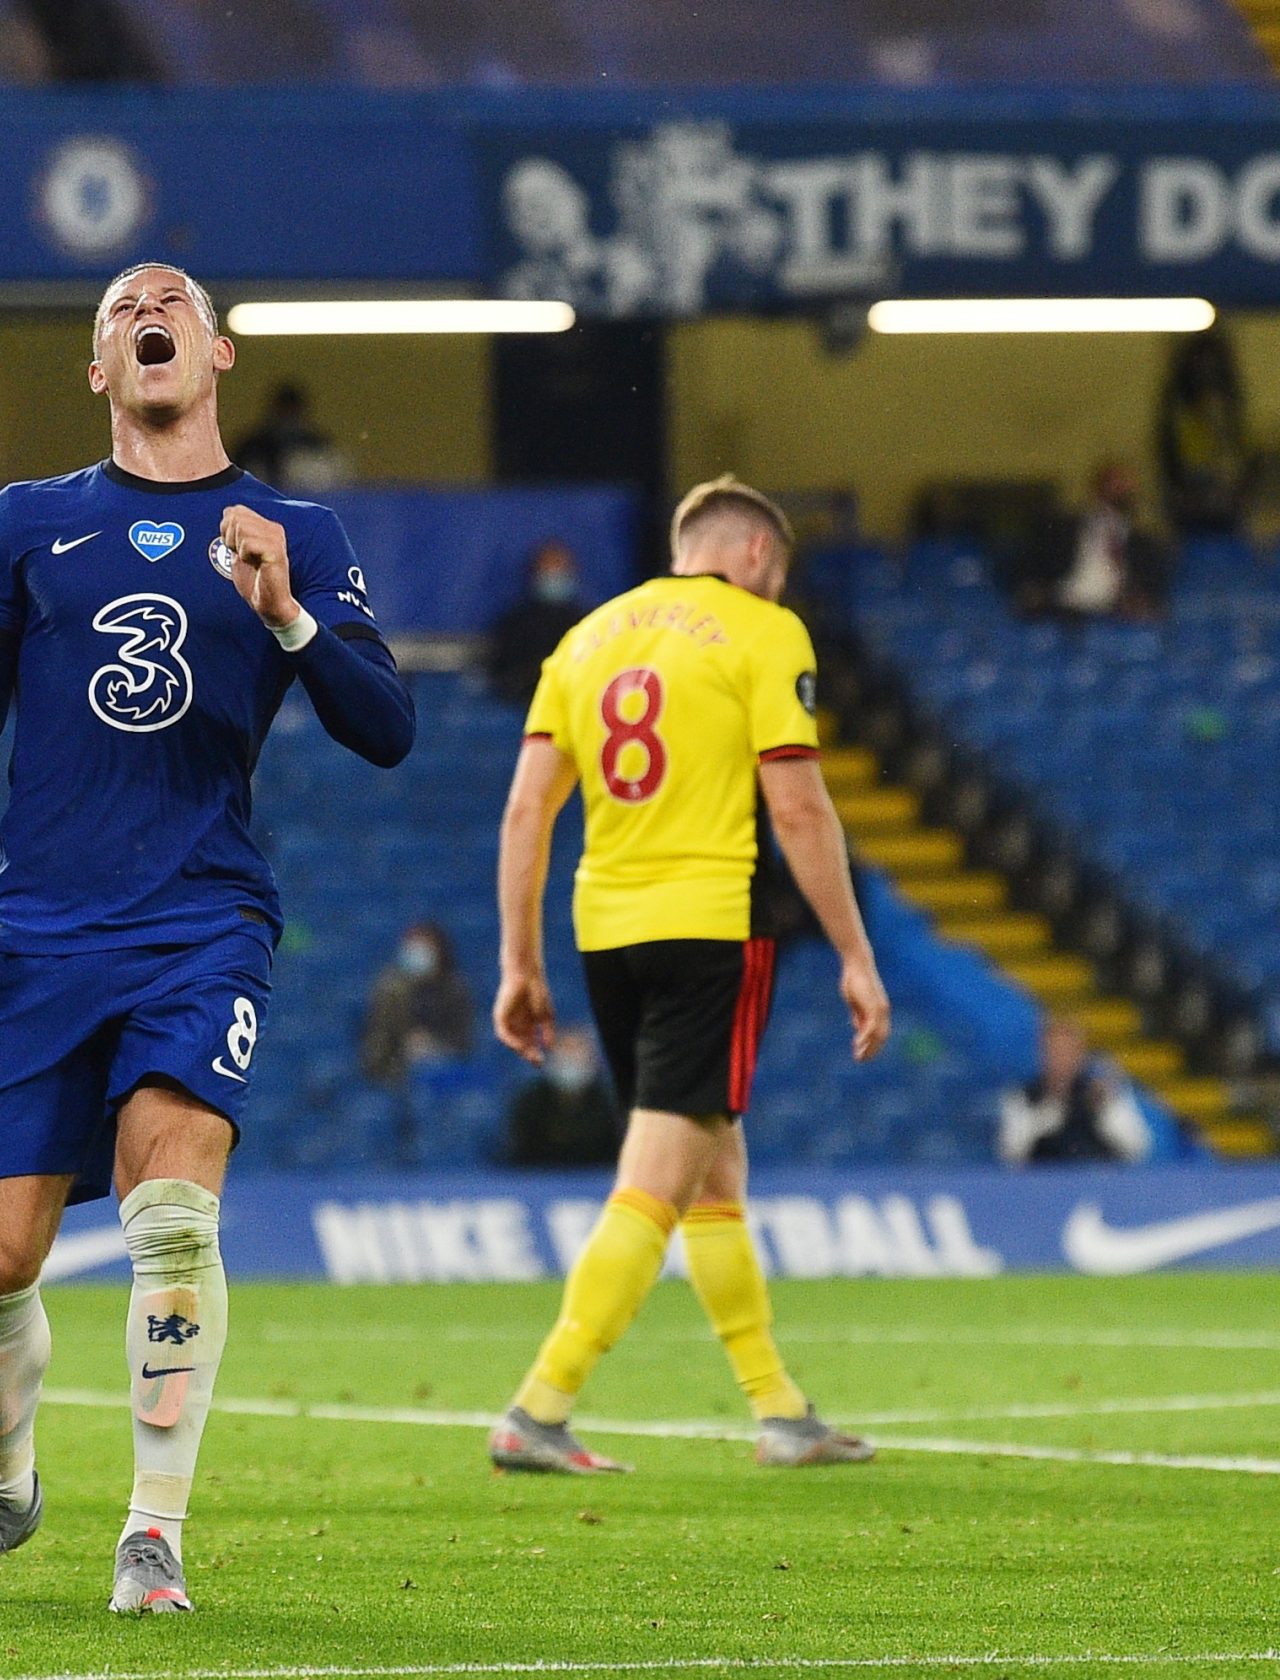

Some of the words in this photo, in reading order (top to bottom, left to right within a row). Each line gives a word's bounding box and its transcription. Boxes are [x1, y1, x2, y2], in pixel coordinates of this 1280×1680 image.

[766, 152, 1116, 260] THEY
[140, 533, 172, 544] NHS
[600, 668, 666, 803] 8
[227, 996, 257, 1071] 8
[316, 1200, 544, 1282] NIKE
[544, 1197, 1003, 1279] FTBALL
